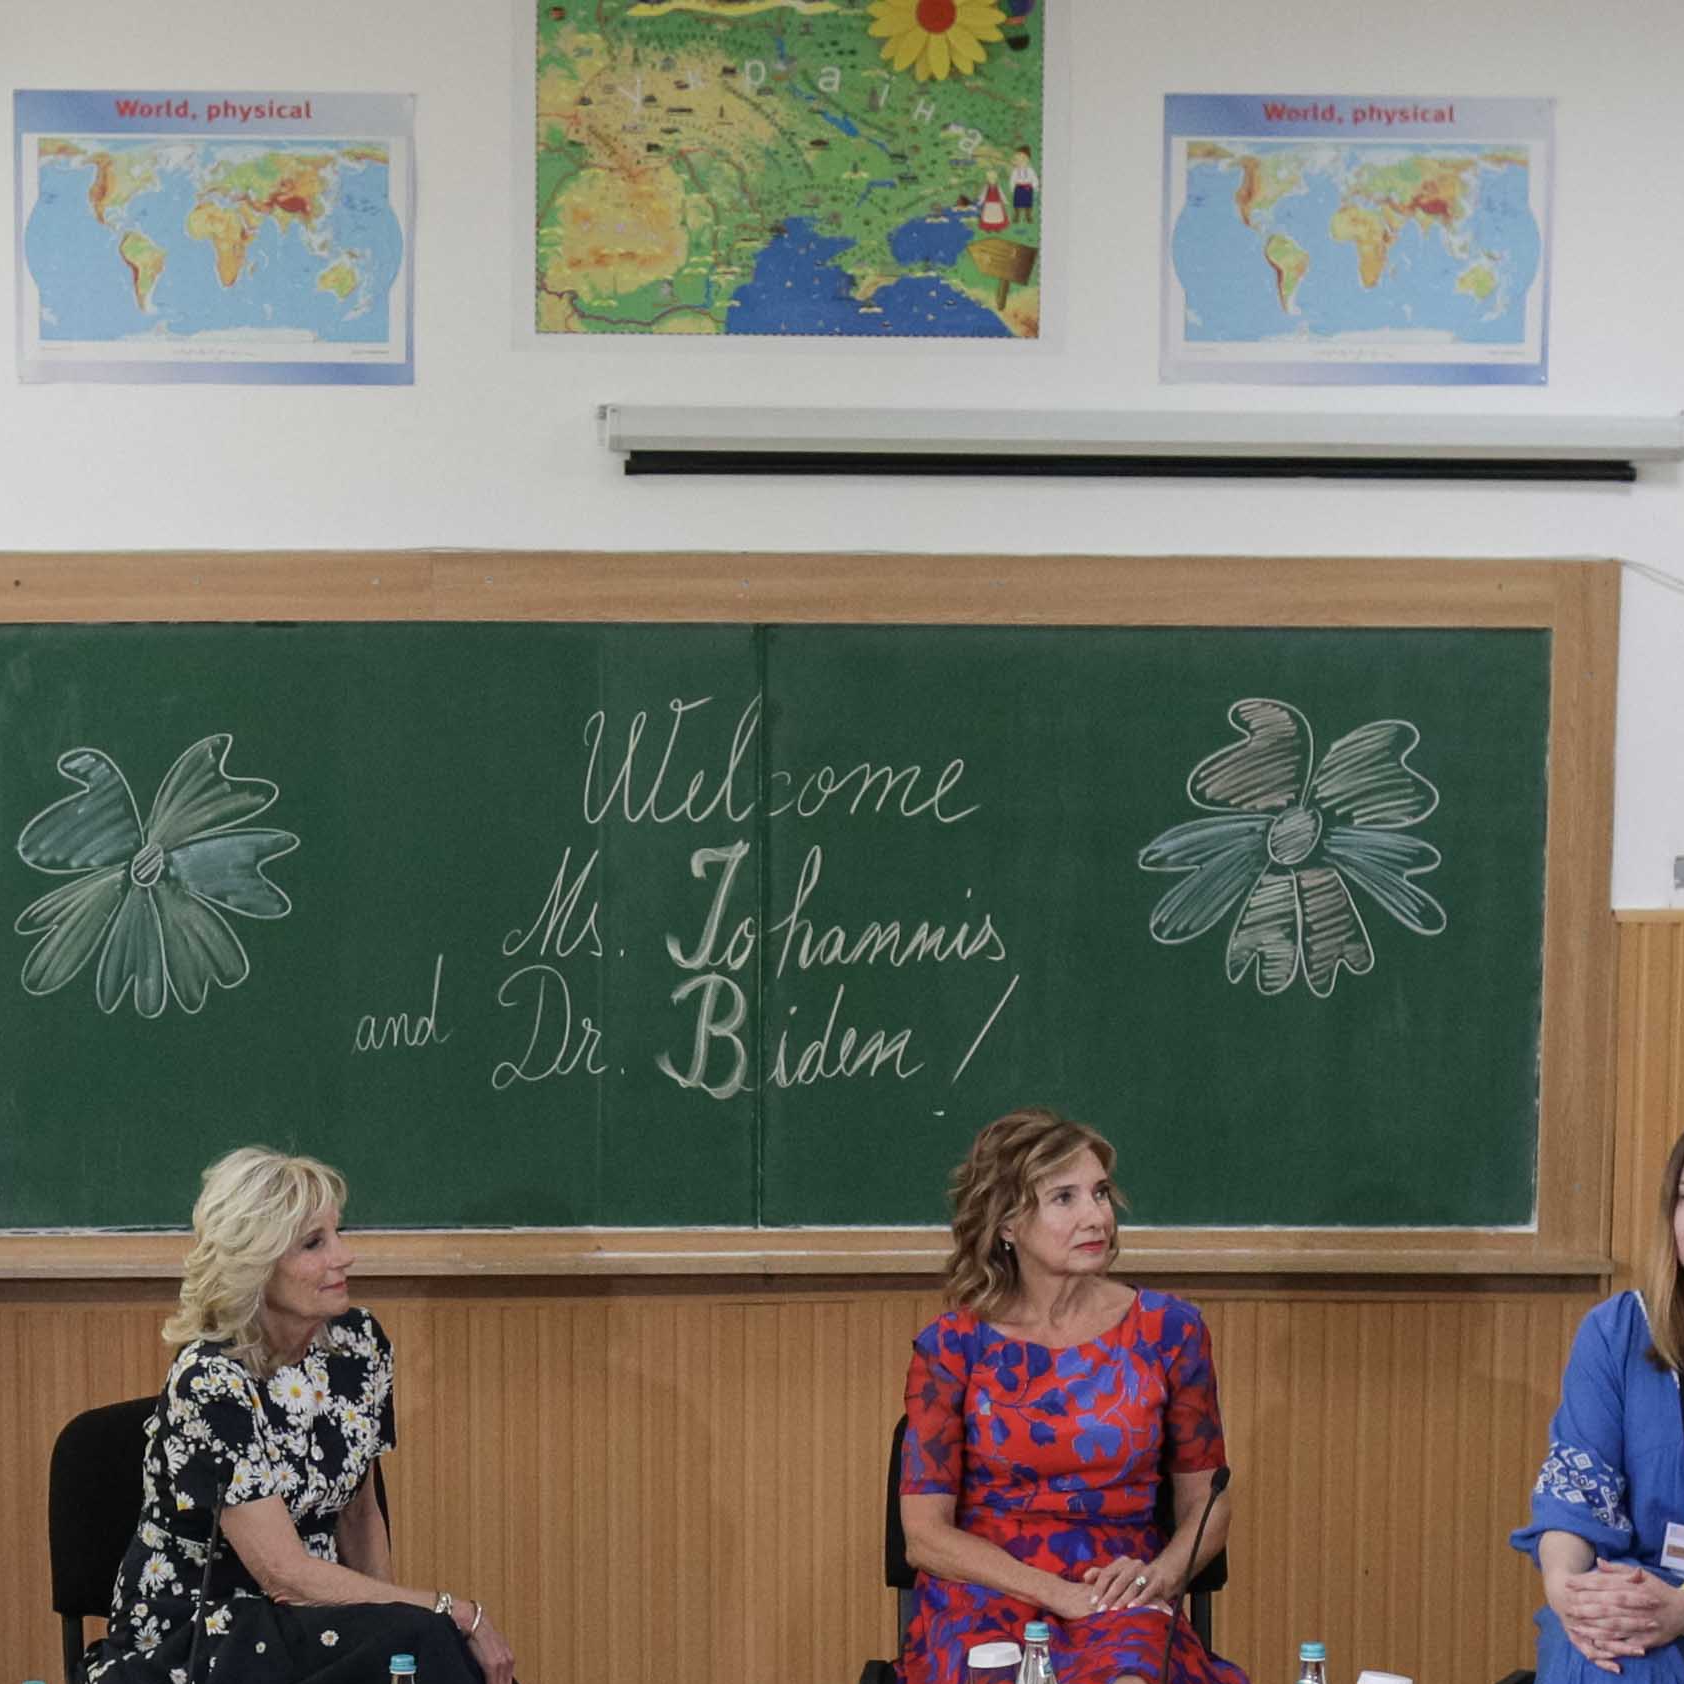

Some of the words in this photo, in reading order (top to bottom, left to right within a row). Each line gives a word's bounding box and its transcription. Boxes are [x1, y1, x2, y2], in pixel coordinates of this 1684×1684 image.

[115, 99, 198, 120] World,
[207, 99, 313, 122] physical
[1263, 103, 1344, 125] World,
[1352, 104, 1455, 126] physical
[584, 693, 982, 824] Welcome
[352, 954, 452, 1055] and
[492, 964, 627, 1091] Dr.
